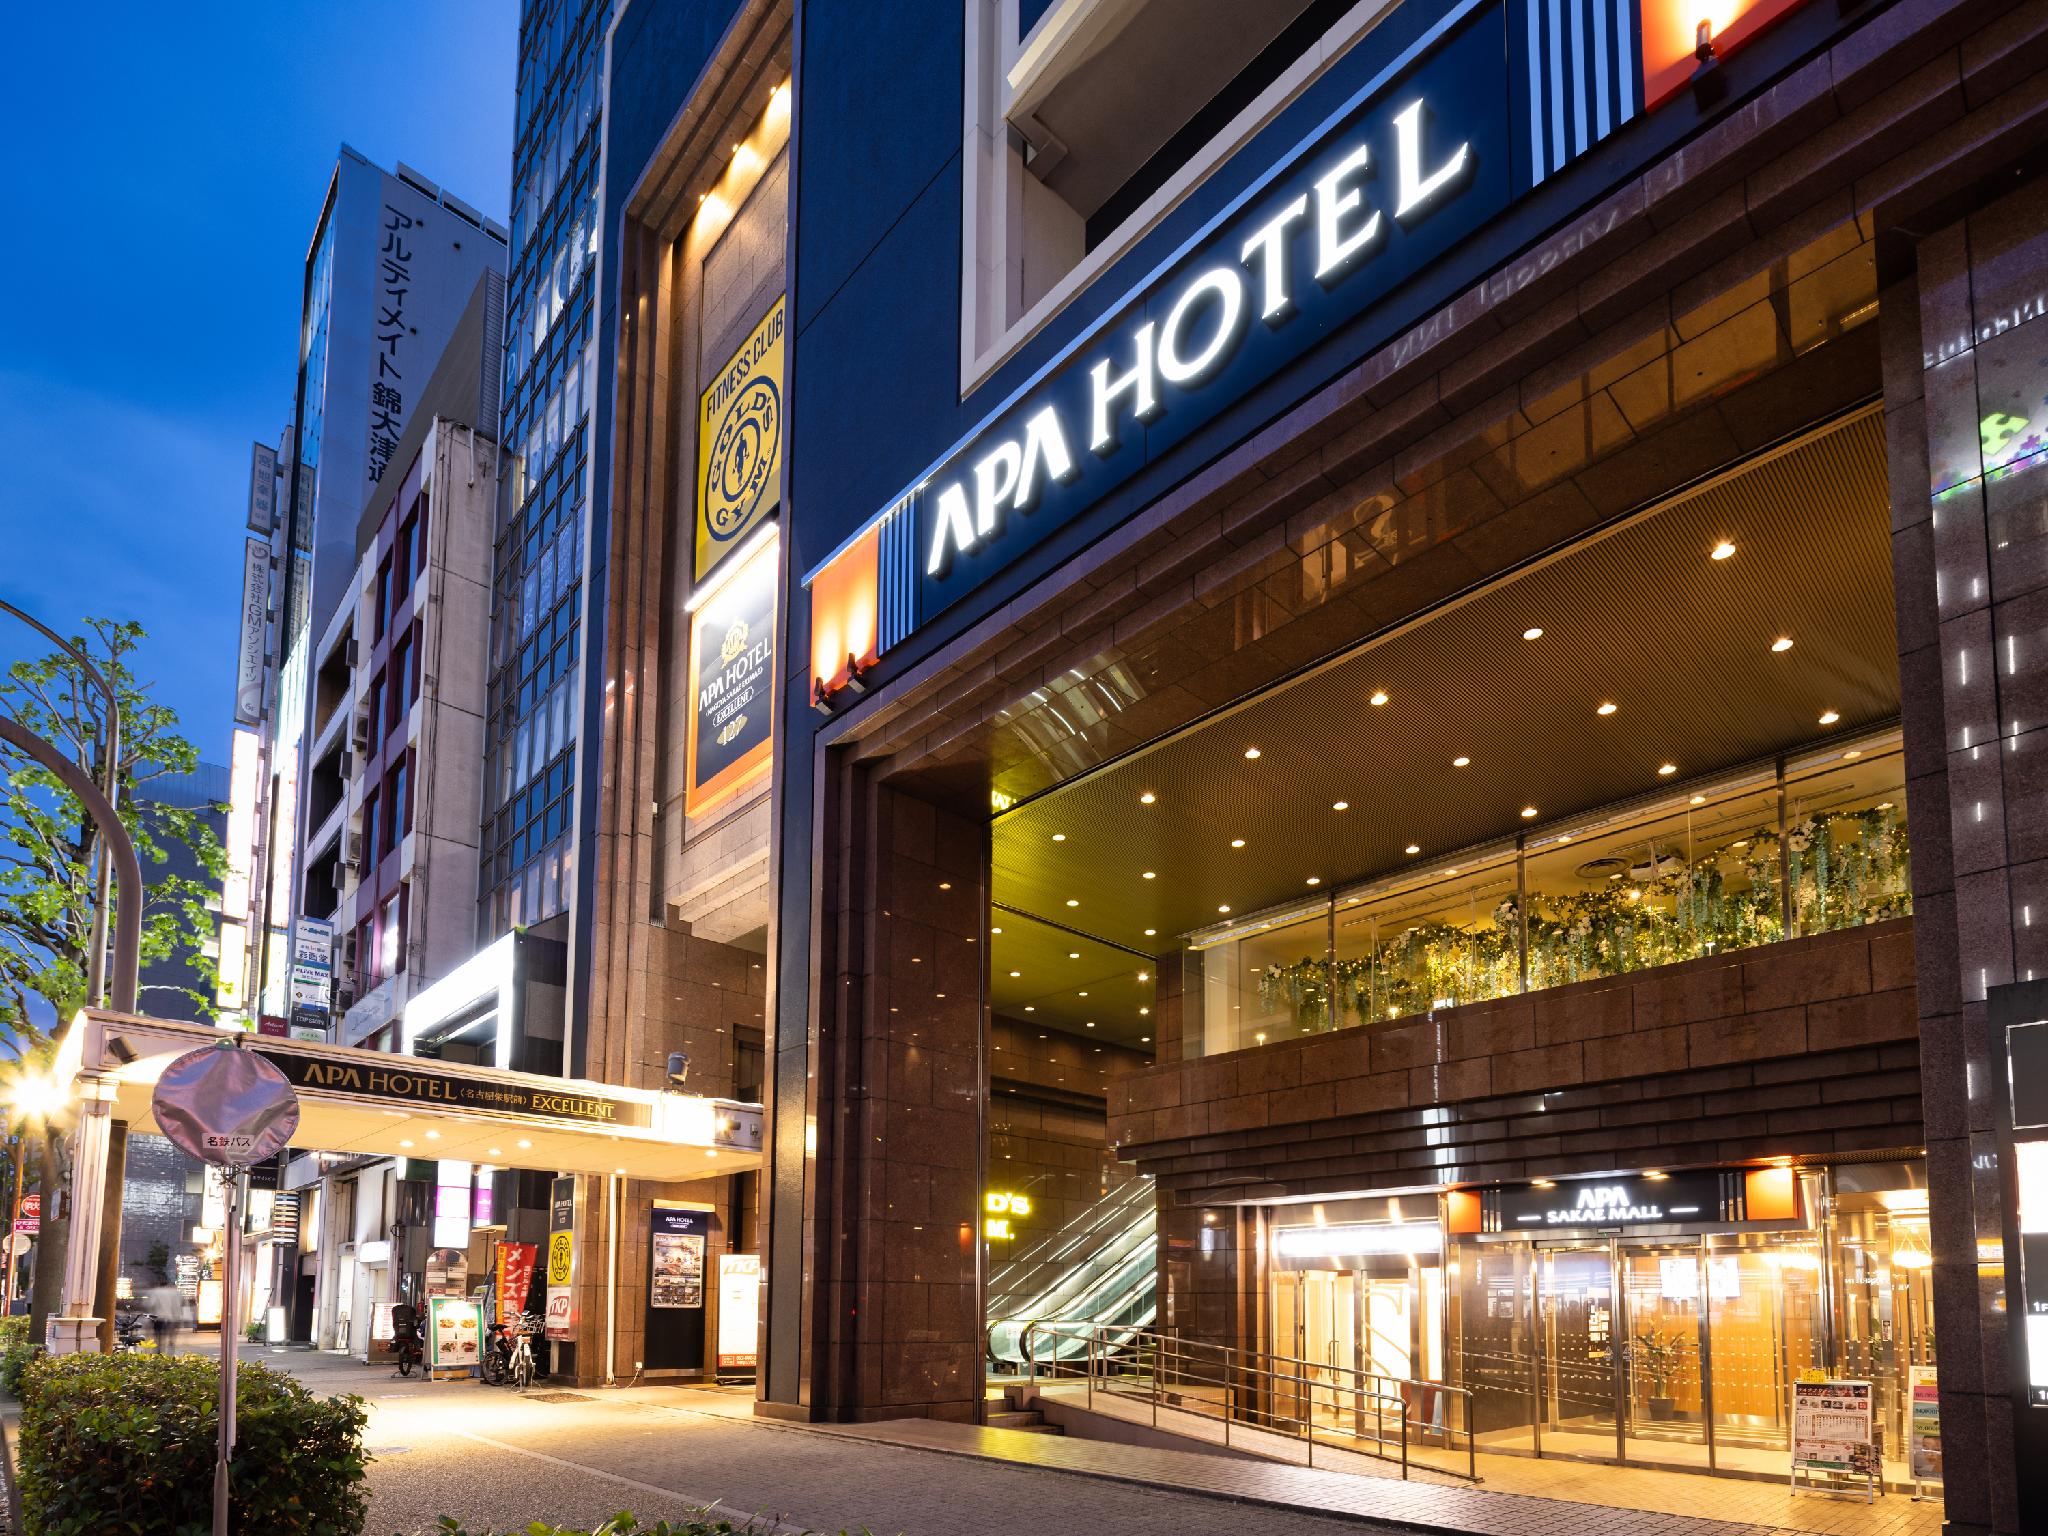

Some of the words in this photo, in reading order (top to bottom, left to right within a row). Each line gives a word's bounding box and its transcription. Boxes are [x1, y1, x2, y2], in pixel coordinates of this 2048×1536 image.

[928, 405, 1071, 575] APA
[1090, 97, 1469, 452] HOTEL
[706, 349, 751, 423] FITNESS
[753, 308, 784, 366] CLUB
[711, 391, 774, 492] GOLD'S
[715, 455, 768, 527] GYM
[699, 677, 725, 711] APA
[726, 637, 772, 690] HOTEL
[716, 690, 750, 723] EXCELLENT
[304, 1063, 361, 1088] APA
[369, 1071, 457, 1100] HOTEL
[533, 1096, 615, 1118] EXCELLENT
[207, 1136, 251, 1147] 名鉄バス
[1547, 1207, 1606, 1223] SAKAE
[1608, 1205, 1662, 1220] MALL
[1577, 1186, 1630, 1208] APA
[550, 1297, 568, 1313] TKP
